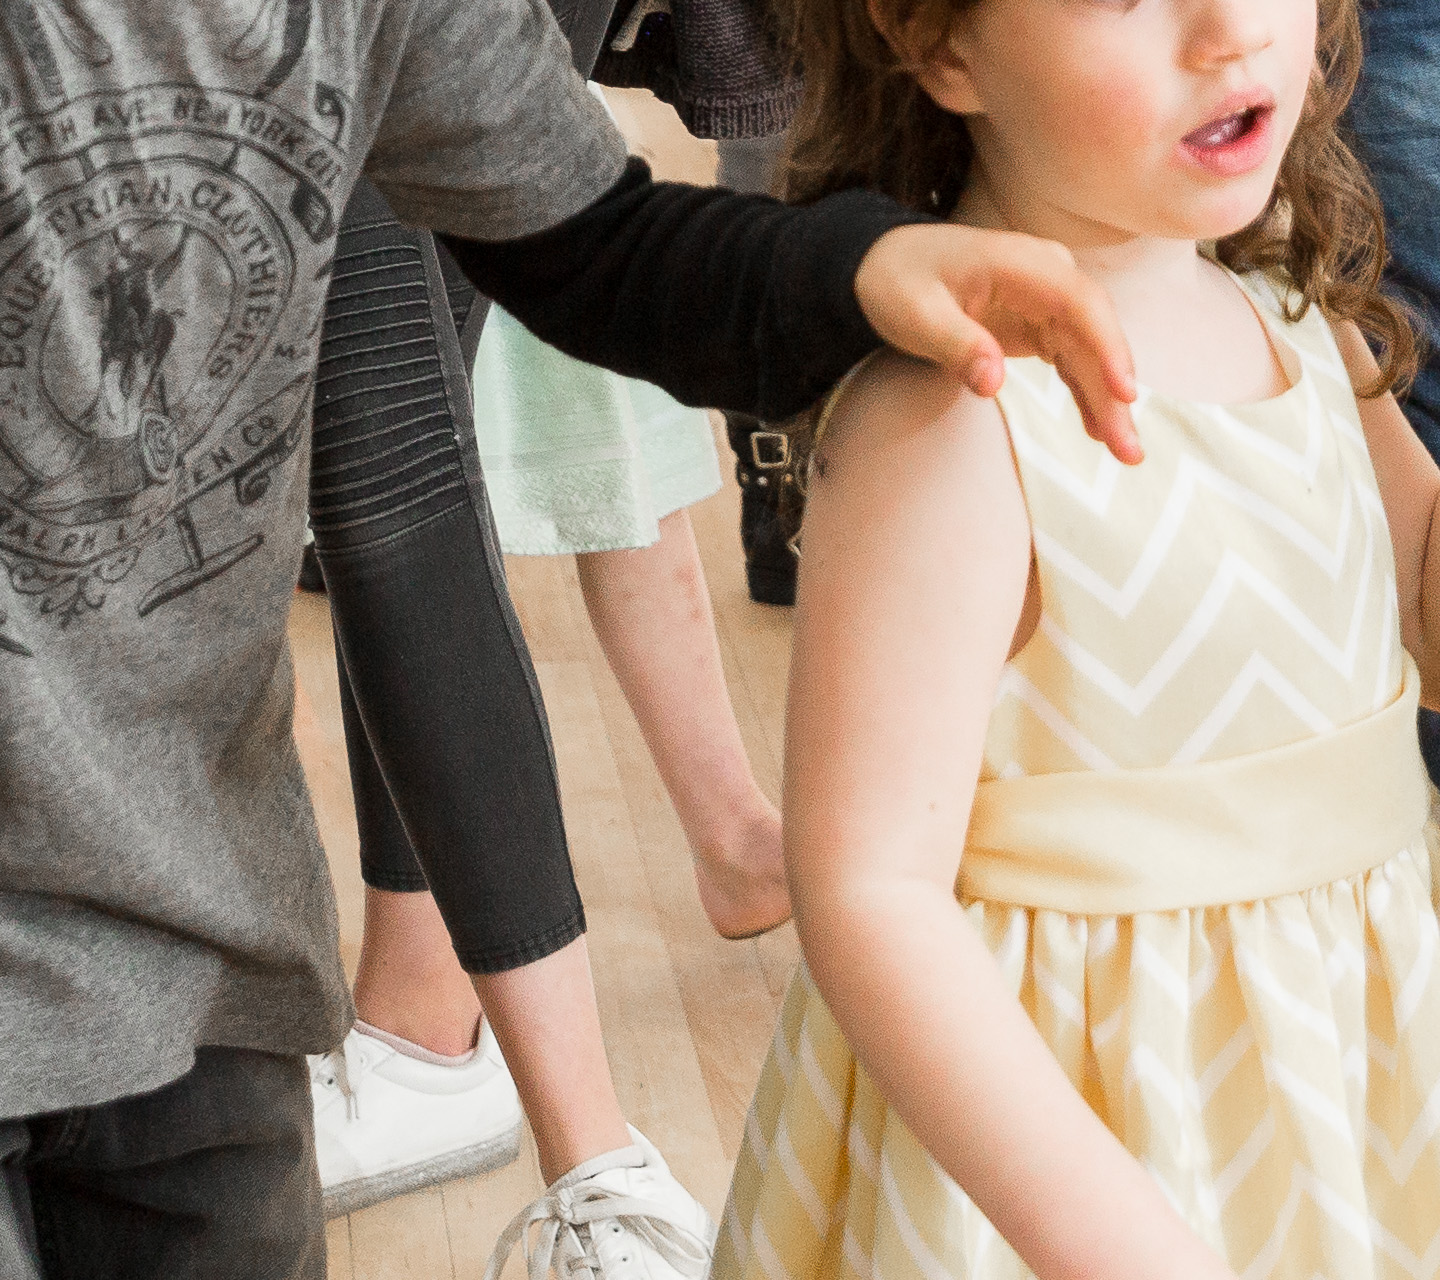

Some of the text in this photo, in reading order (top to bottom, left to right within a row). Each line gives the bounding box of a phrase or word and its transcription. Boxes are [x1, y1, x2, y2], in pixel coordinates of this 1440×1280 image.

[93, 97, 148, 129] AVE
[239, 107, 306, 158] YORK
[190, 180, 279, 382] CLOTHIERS
